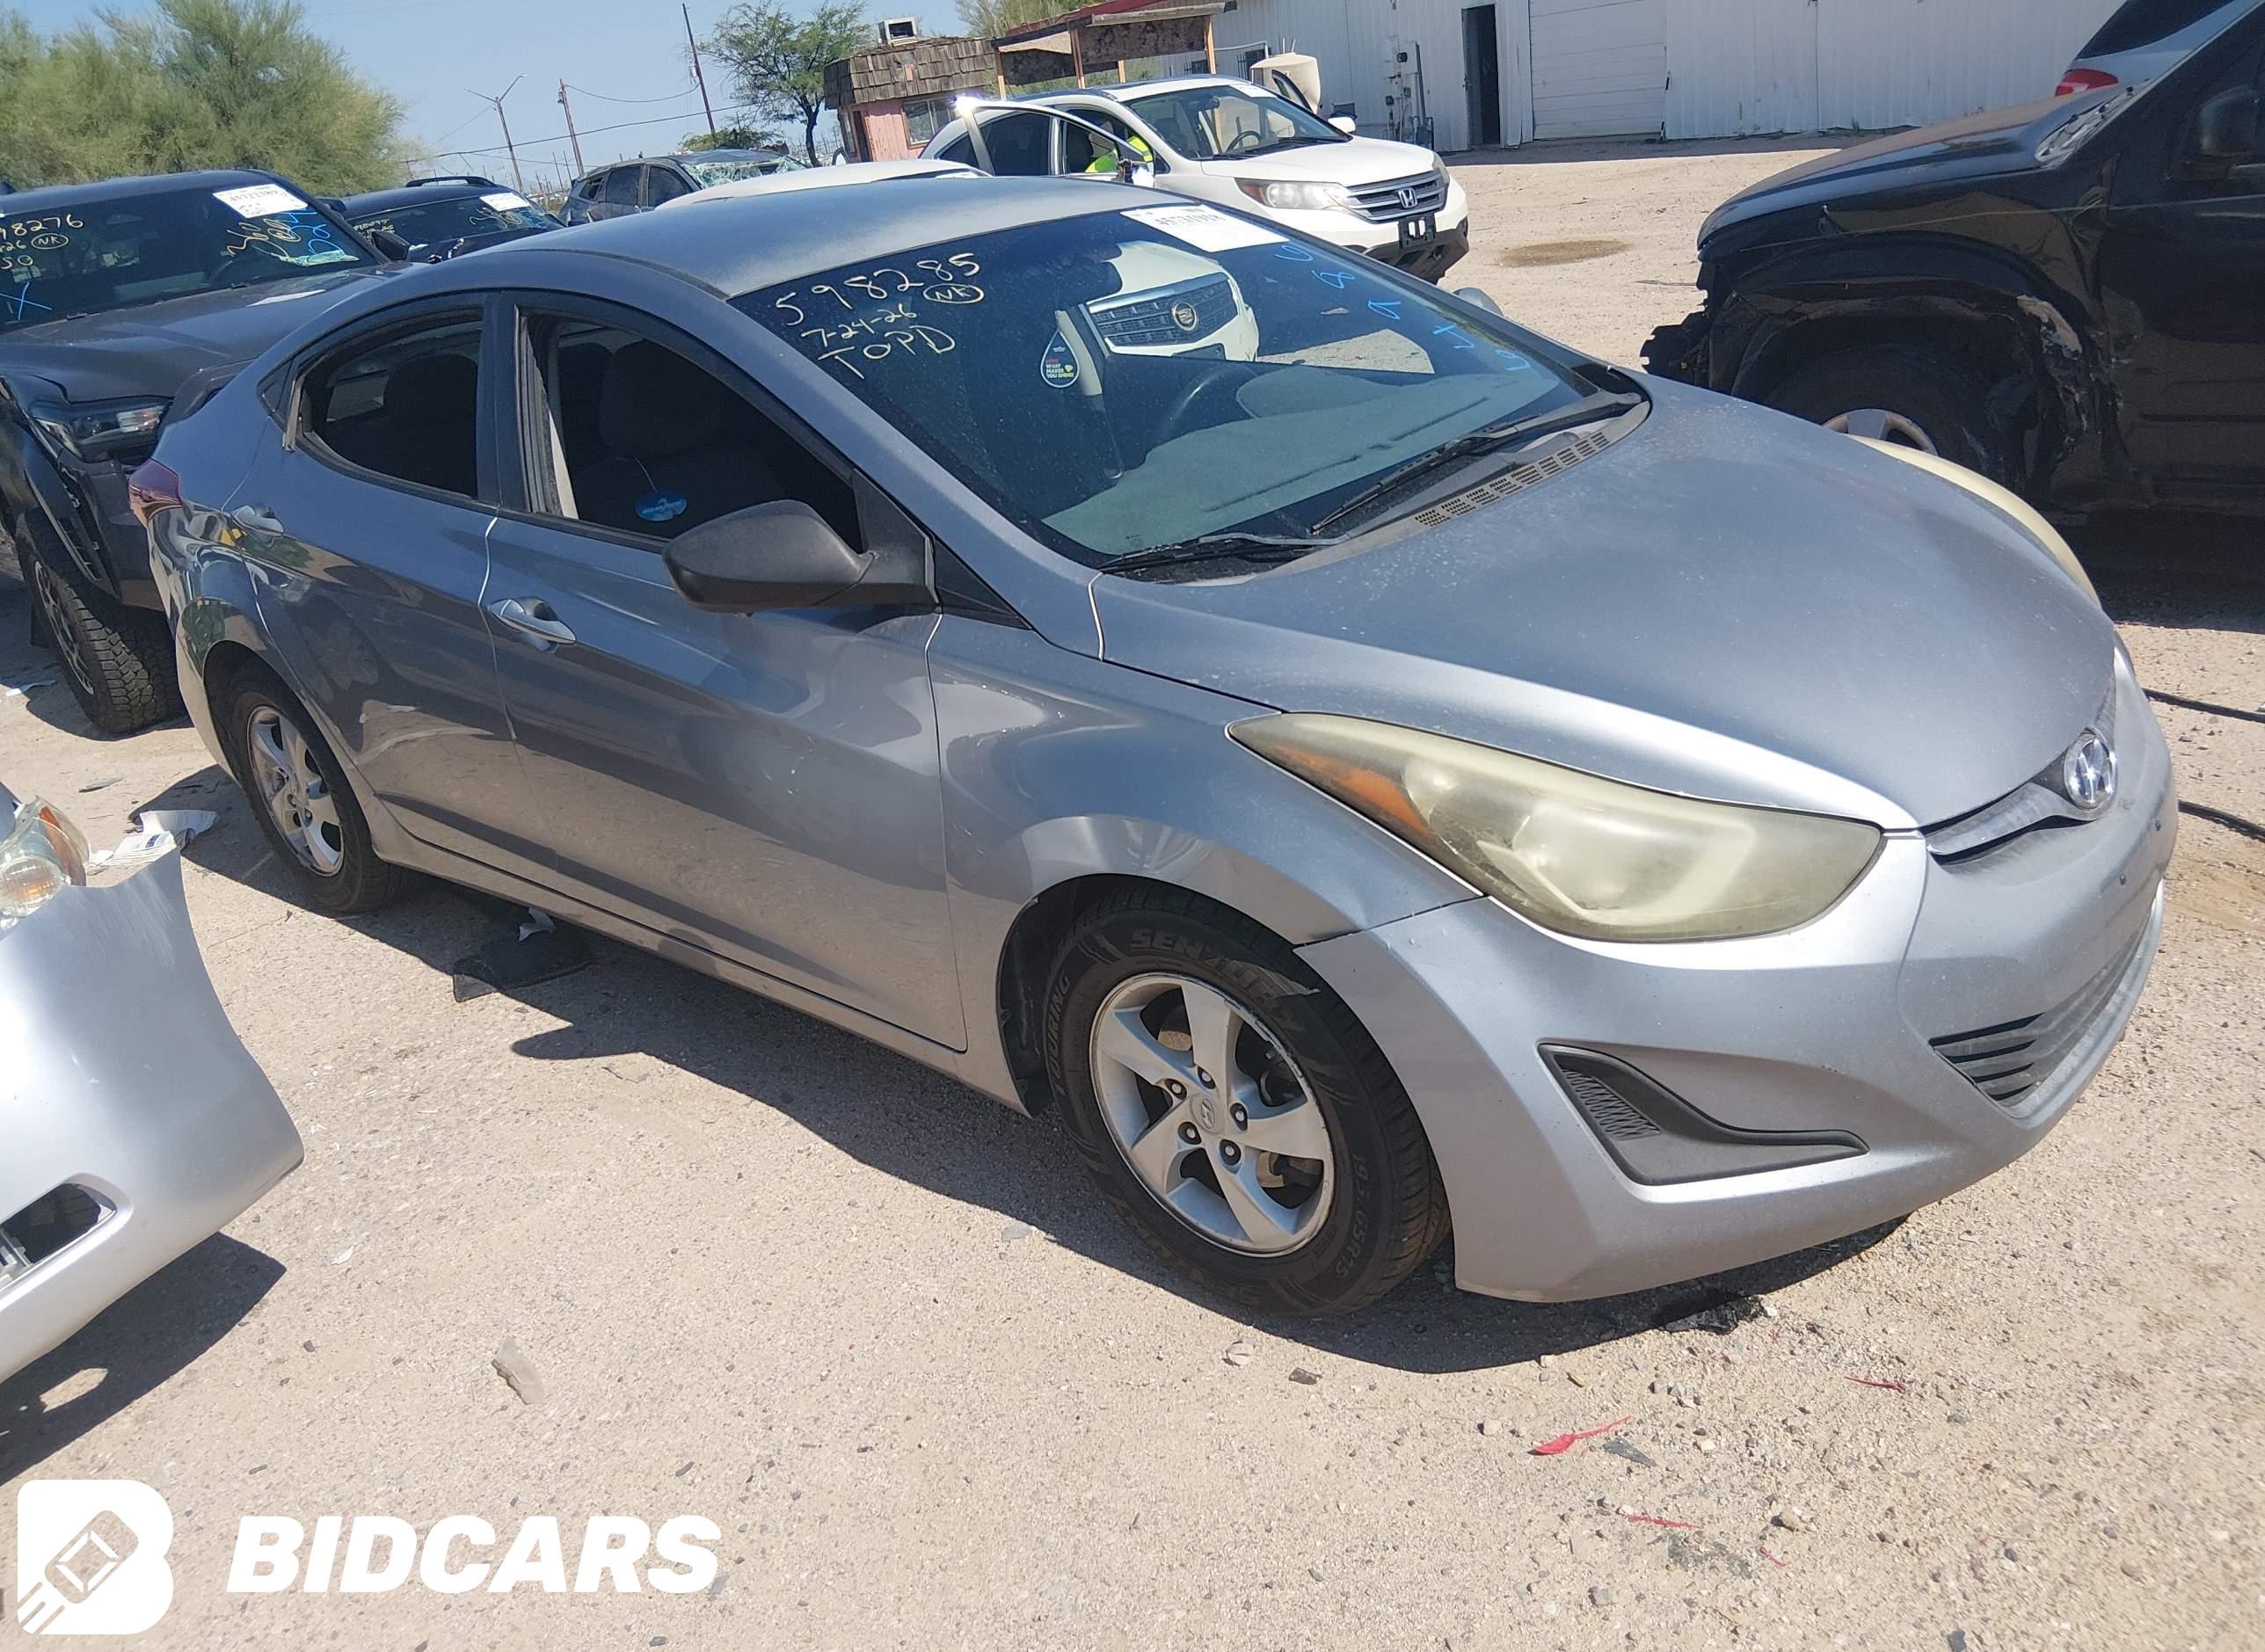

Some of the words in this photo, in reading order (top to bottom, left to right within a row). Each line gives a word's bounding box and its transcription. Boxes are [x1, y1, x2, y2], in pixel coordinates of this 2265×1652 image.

[776, 252, 980, 326] 598285
[801, 303, 917, 347] 7-24-26
[818, 325, 956, 380] TOPD
